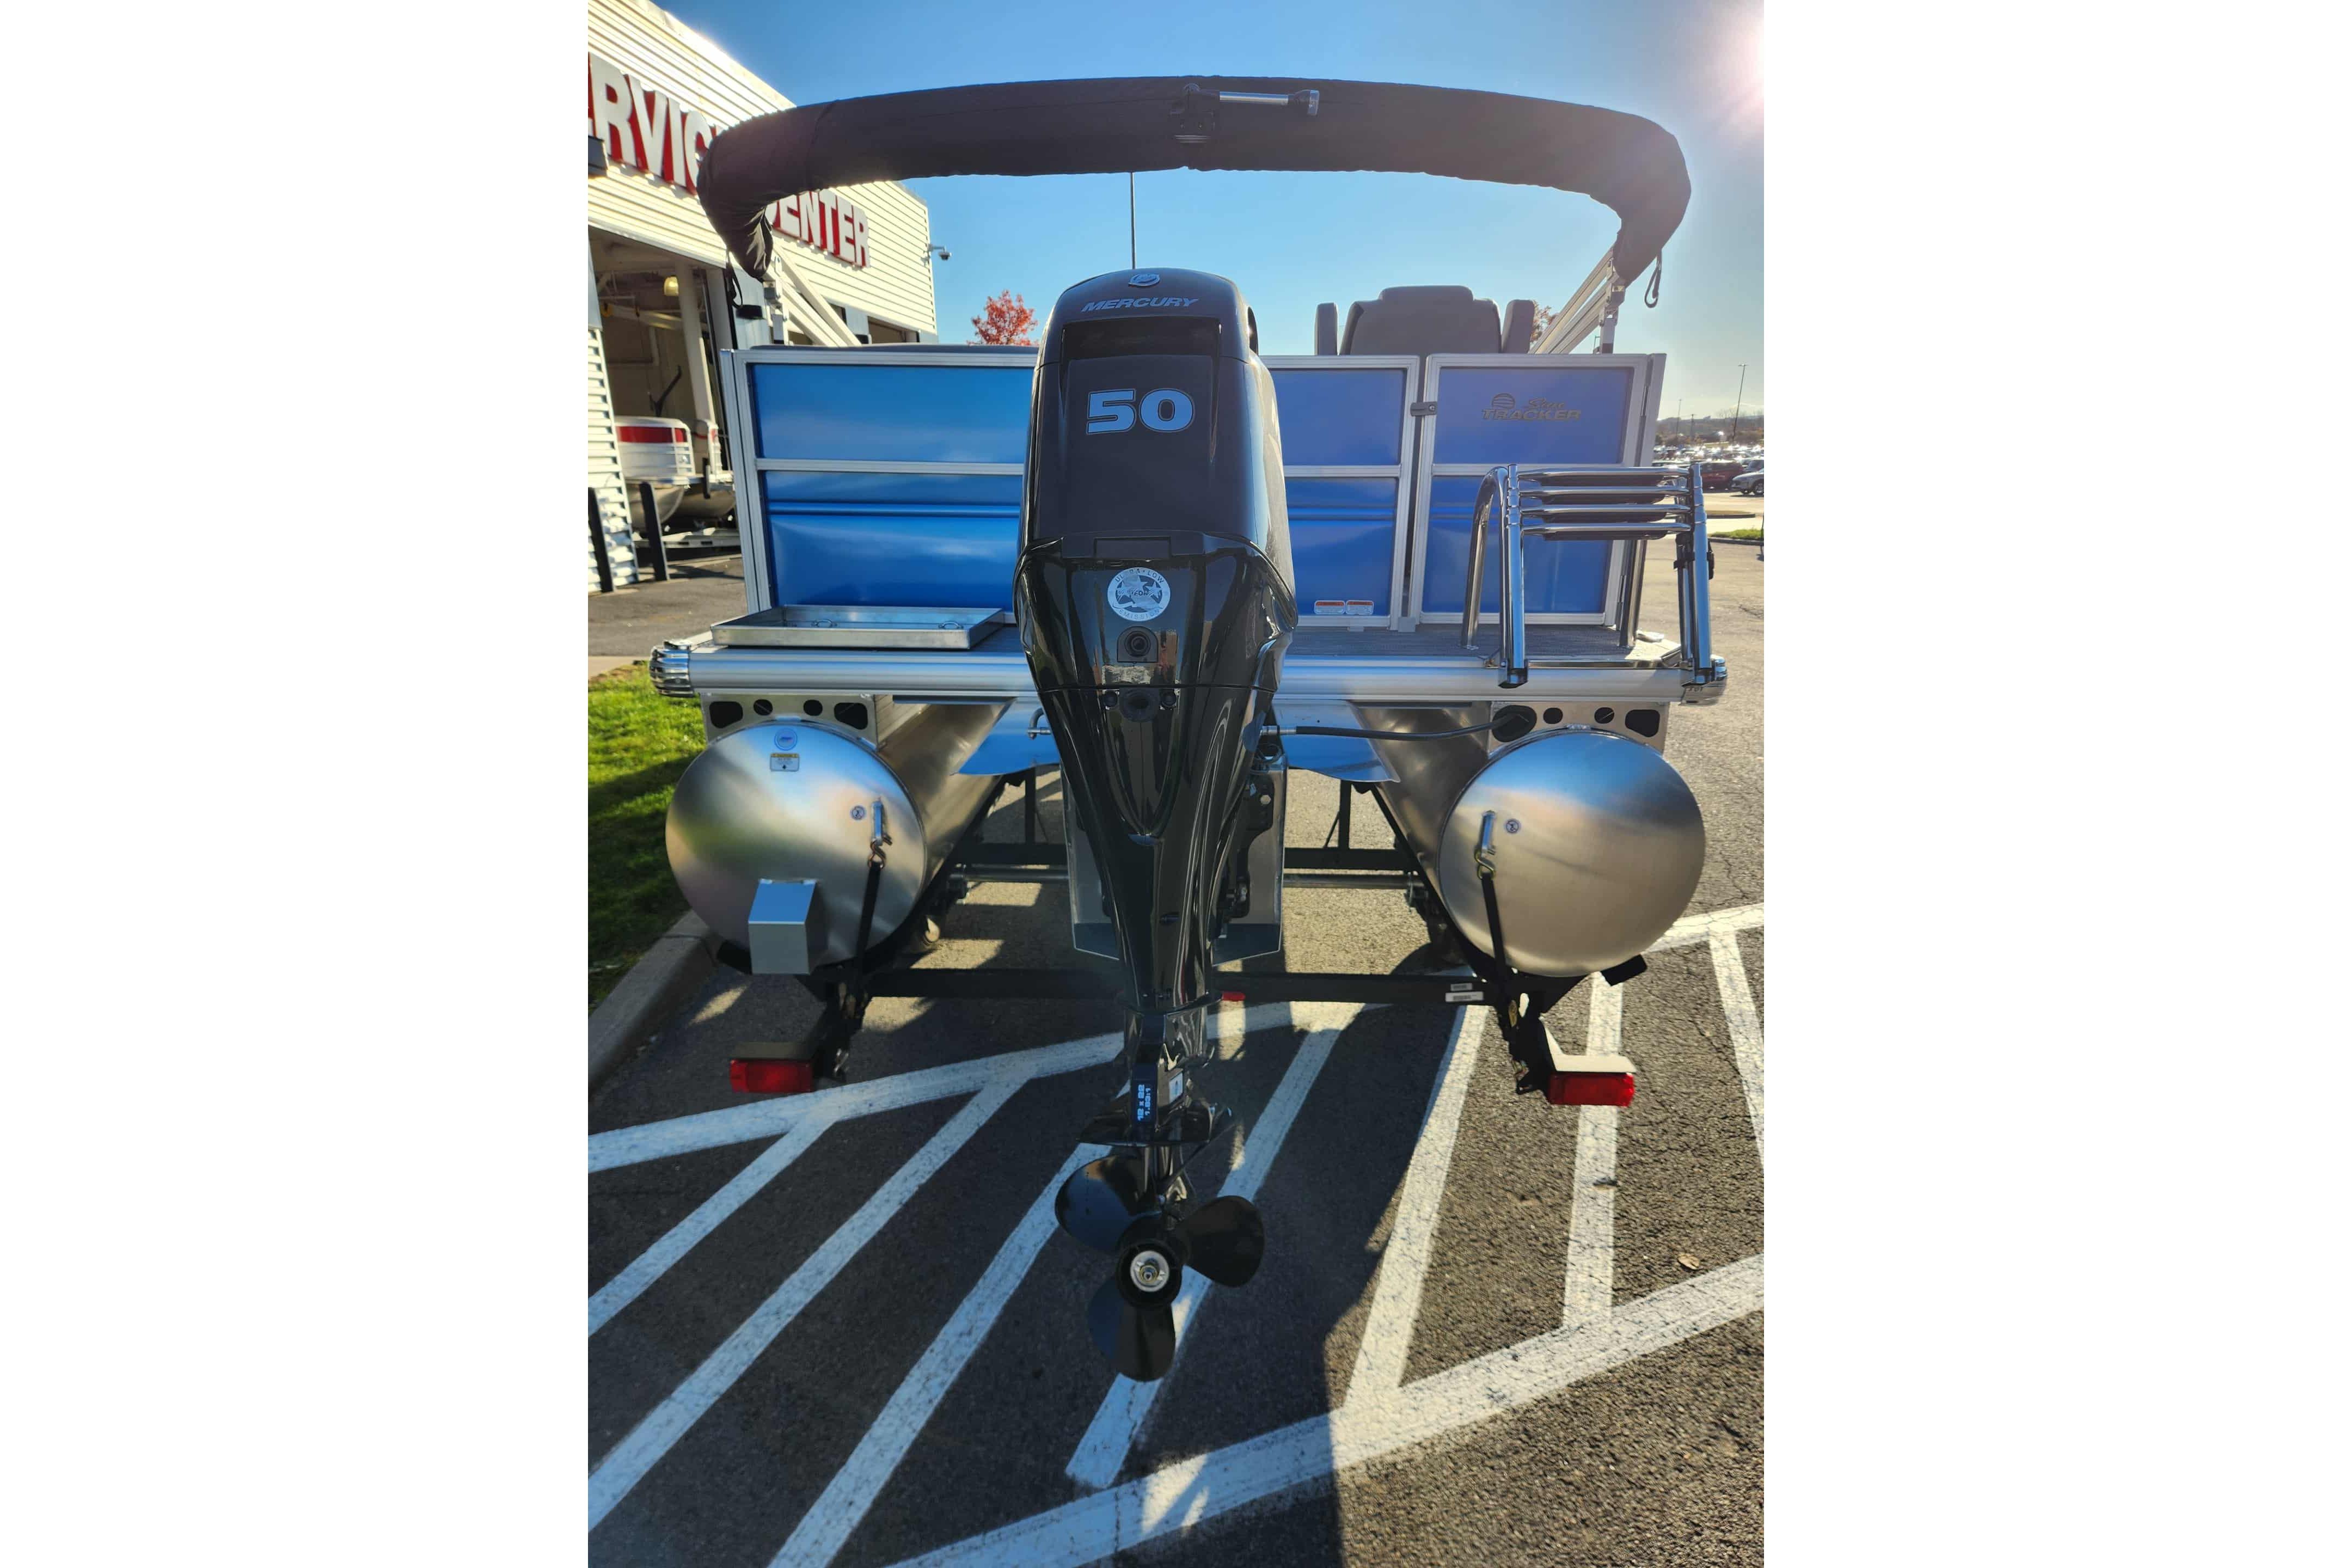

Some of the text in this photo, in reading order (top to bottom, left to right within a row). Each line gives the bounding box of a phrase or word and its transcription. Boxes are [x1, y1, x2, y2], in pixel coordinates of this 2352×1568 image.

[588, 52, 871, 268] RVIC ENTER
[1081, 297, 1199, 313] MERCURY
[1087, 388, 1195, 434] 50
[1481, 409, 1582, 420] TRACKER
